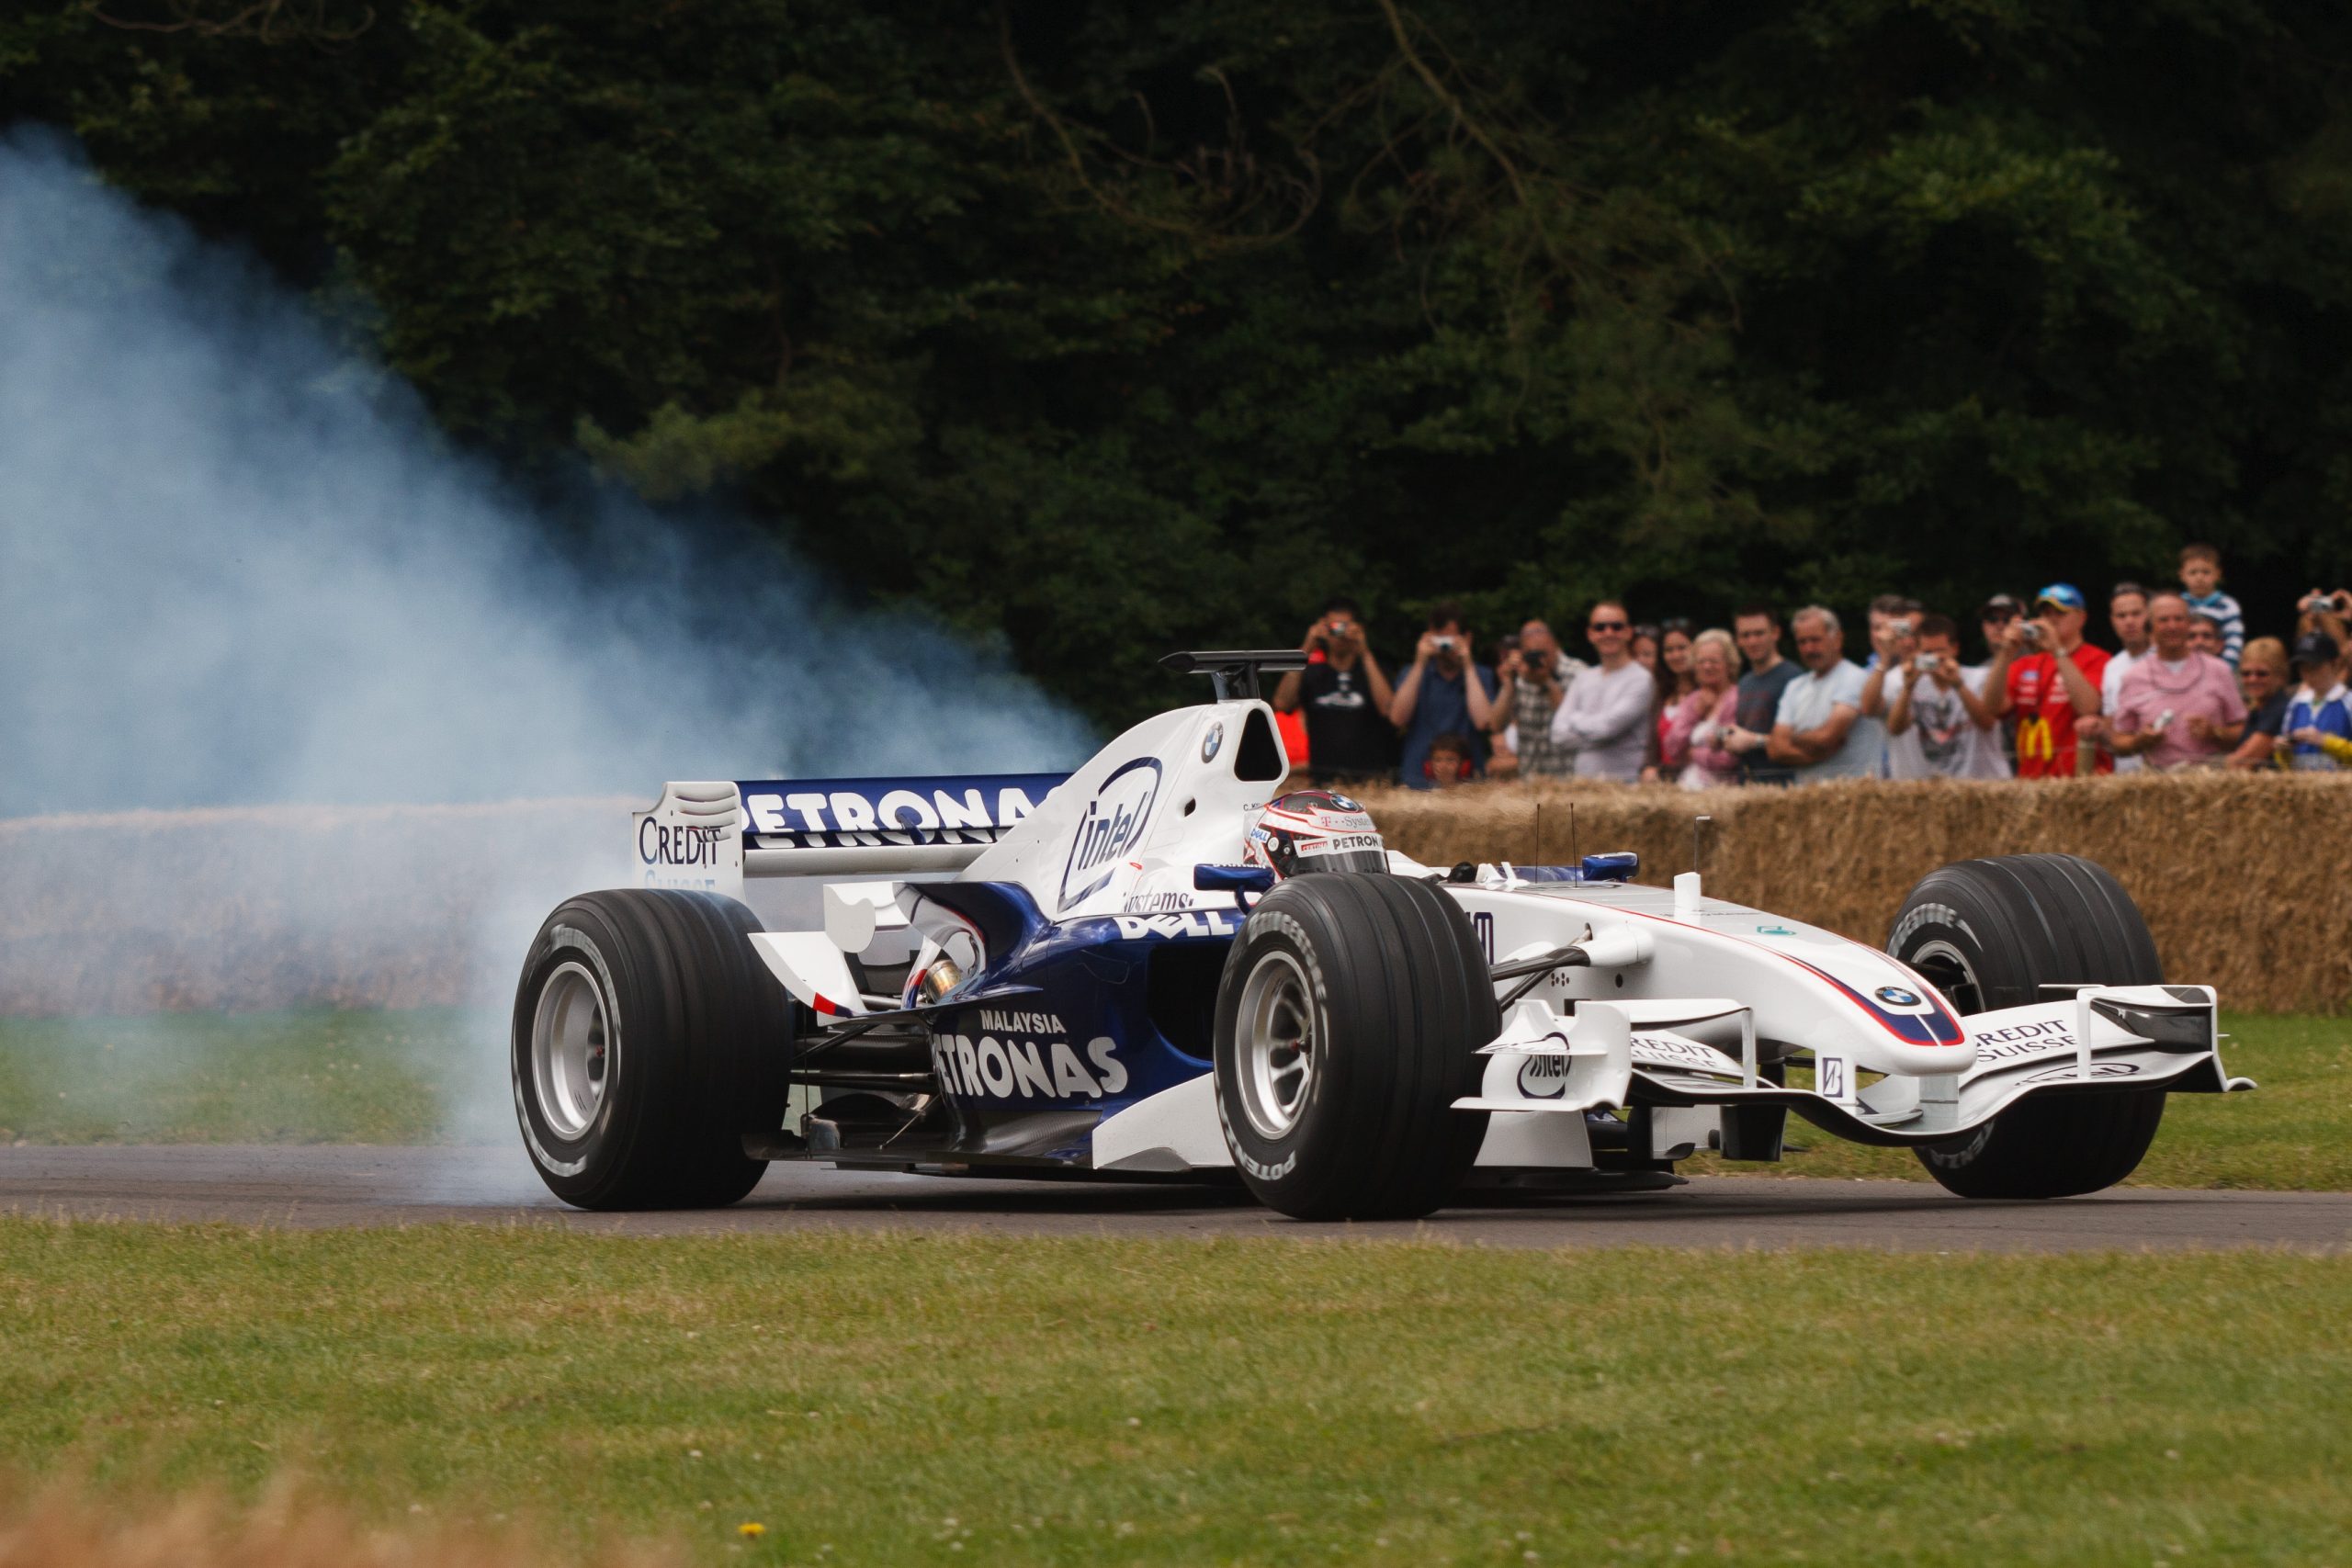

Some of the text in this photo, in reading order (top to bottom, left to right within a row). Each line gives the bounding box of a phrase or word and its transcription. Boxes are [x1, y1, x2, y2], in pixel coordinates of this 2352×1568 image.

[741, 786, 1066, 848] ETRONA
[639, 816, 720, 864] CREDIT
[1332, 835, 1383, 851] PETRON
[1123, 889, 1186, 914] ystems
[1113, 911, 1234, 940] DELL
[980, 1010, 1067, 1034] MALAYSIA
[1974, 1020, 2067, 1047] REDIT
[1631, 1037, 1713, 1058] REDIT
[1632, 1050, 1717, 1067] UISSE
[1977, 1035, 2077, 1062] SUISSE
[933, 1034, 1128, 1099] ETRONAS
